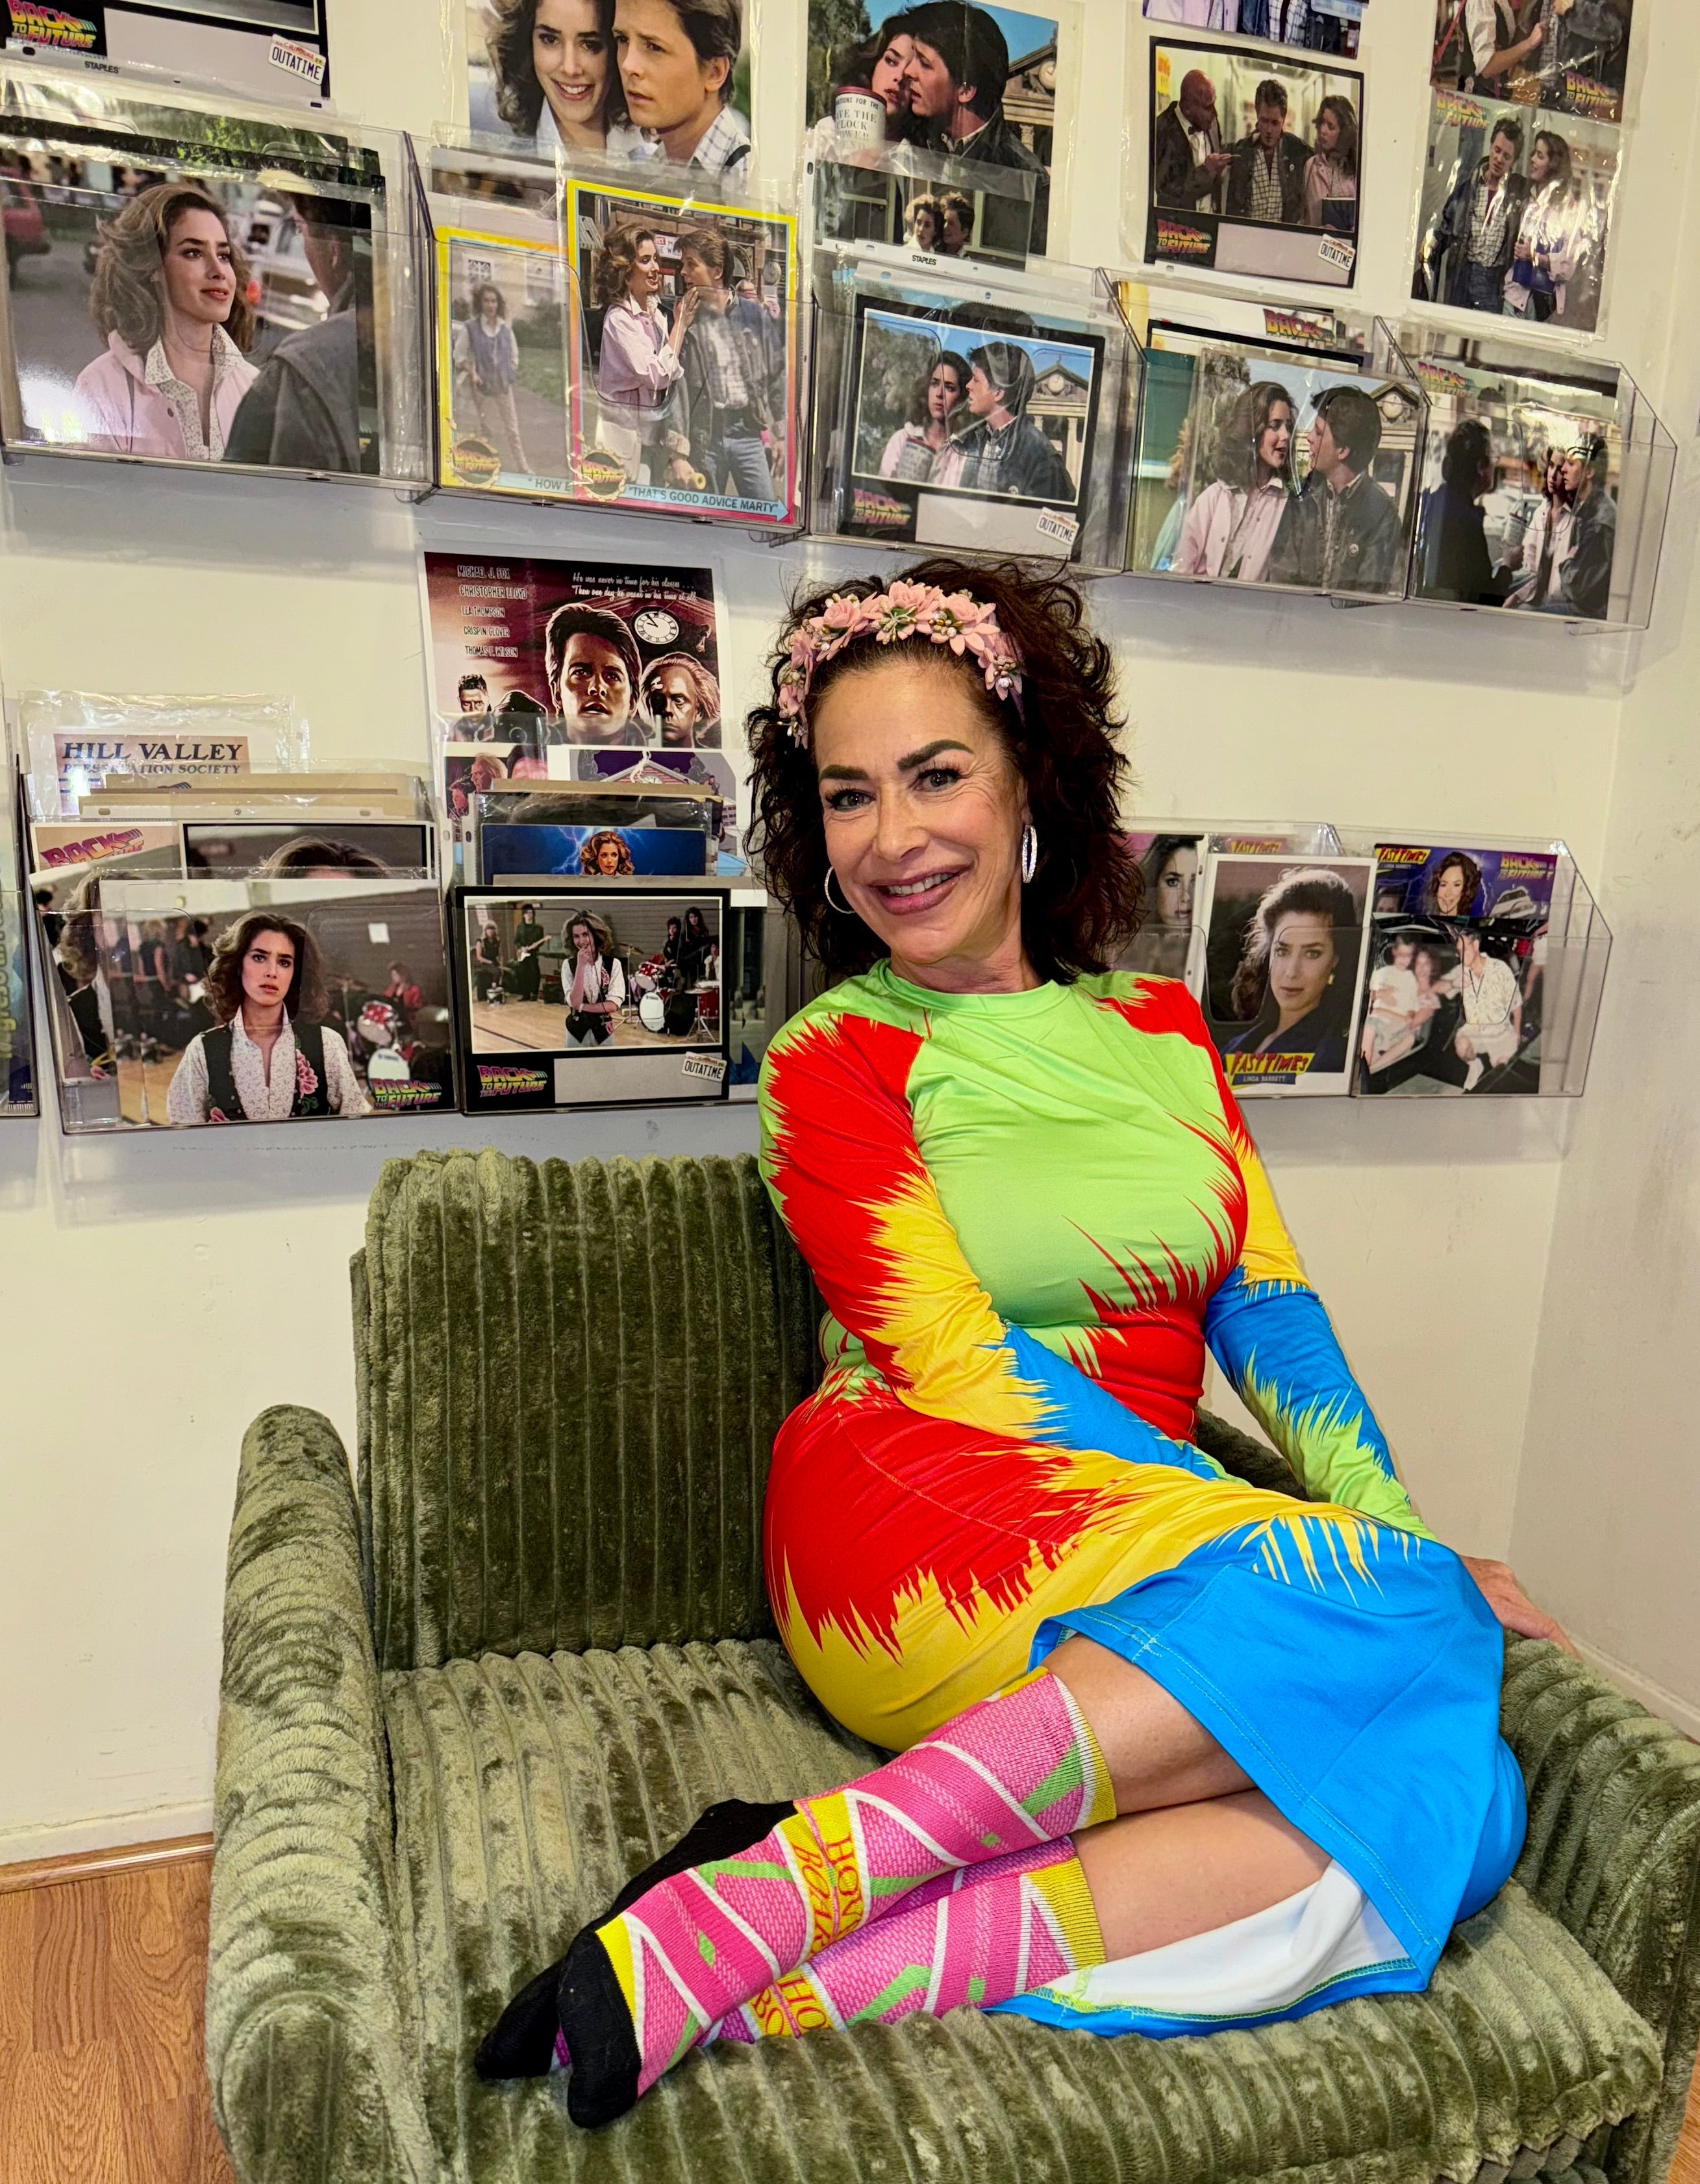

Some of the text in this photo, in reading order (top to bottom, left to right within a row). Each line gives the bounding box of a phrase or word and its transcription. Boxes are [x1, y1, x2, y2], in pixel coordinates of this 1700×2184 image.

[7, 0, 97, 32] BACK
[12, 22, 27, 33] TO
[27, 25, 96, 48] FUTURE
[84, 60, 119, 74] STAPLES
[272, 46, 322, 81] OUTATIME
[1566, 71, 1619, 97] BACK
[1157, 218, 1212, 242] BACK
[1167, 239, 1211, 254] FUTURE
[912, 255, 937, 266] STAPLES
[1320, 243, 1353, 268] OUTATIME
[1263, 308, 1334, 338] BACK
[535, 479, 562, 490] HOW
[669, 490, 699, 504] GOOD
[701, 496, 738, 509] ADVICE
[740, 501, 779, 513] MARTY"
[853, 488, 912, 513] BACK
[862, 508, 911, 525] FUTURE
[1039, 517, 1075, 542] OUTATIME
[457, 565, 511, 580] MICHAEL J. FOX
[573, 572, 583, 583] He
[624, 576, 638, 585] time
[639, 576, 649, 592] for
[651, 577, 660, 586] his
[459, 585, 527, 600] CHRISTOPHER LLOYD
[571, 585, 591, 595] Then
[604, 586, 615, 601] day
[617, 587, 625, 597] he
[653, 589, 662, 599] his
[664, 590, 677, 600] time
[462, 605, 505, 618] LEA THOMPSON
[463, 625, 510, 638] CRISPIN GLOVER
[465, 646, 488, 657] THOMAS
[495, 647, 519, 659] WILSON
[62, 742, 243, 760] HILL VALLEY
[179, 764, 241, 774] SOCIETY
[40, 828, 144, 868] BACK
[1378, 847, 1427, 863] FAST TIMES
[1501, 854, 1547, 869] BACK
[684, 1061, 723, 1079] OUTATIME
[1231, 1051, 1309, 1075] FAST TIMES
[477, 1065, 547, 1083] BACK
[370, 1078, 442, 1095] BACK
[482, 1082, 493, 1090] TO
[494, 1080, 547, 1096] FUTURE
[388, 1092, 442, 1108] FUTURE
